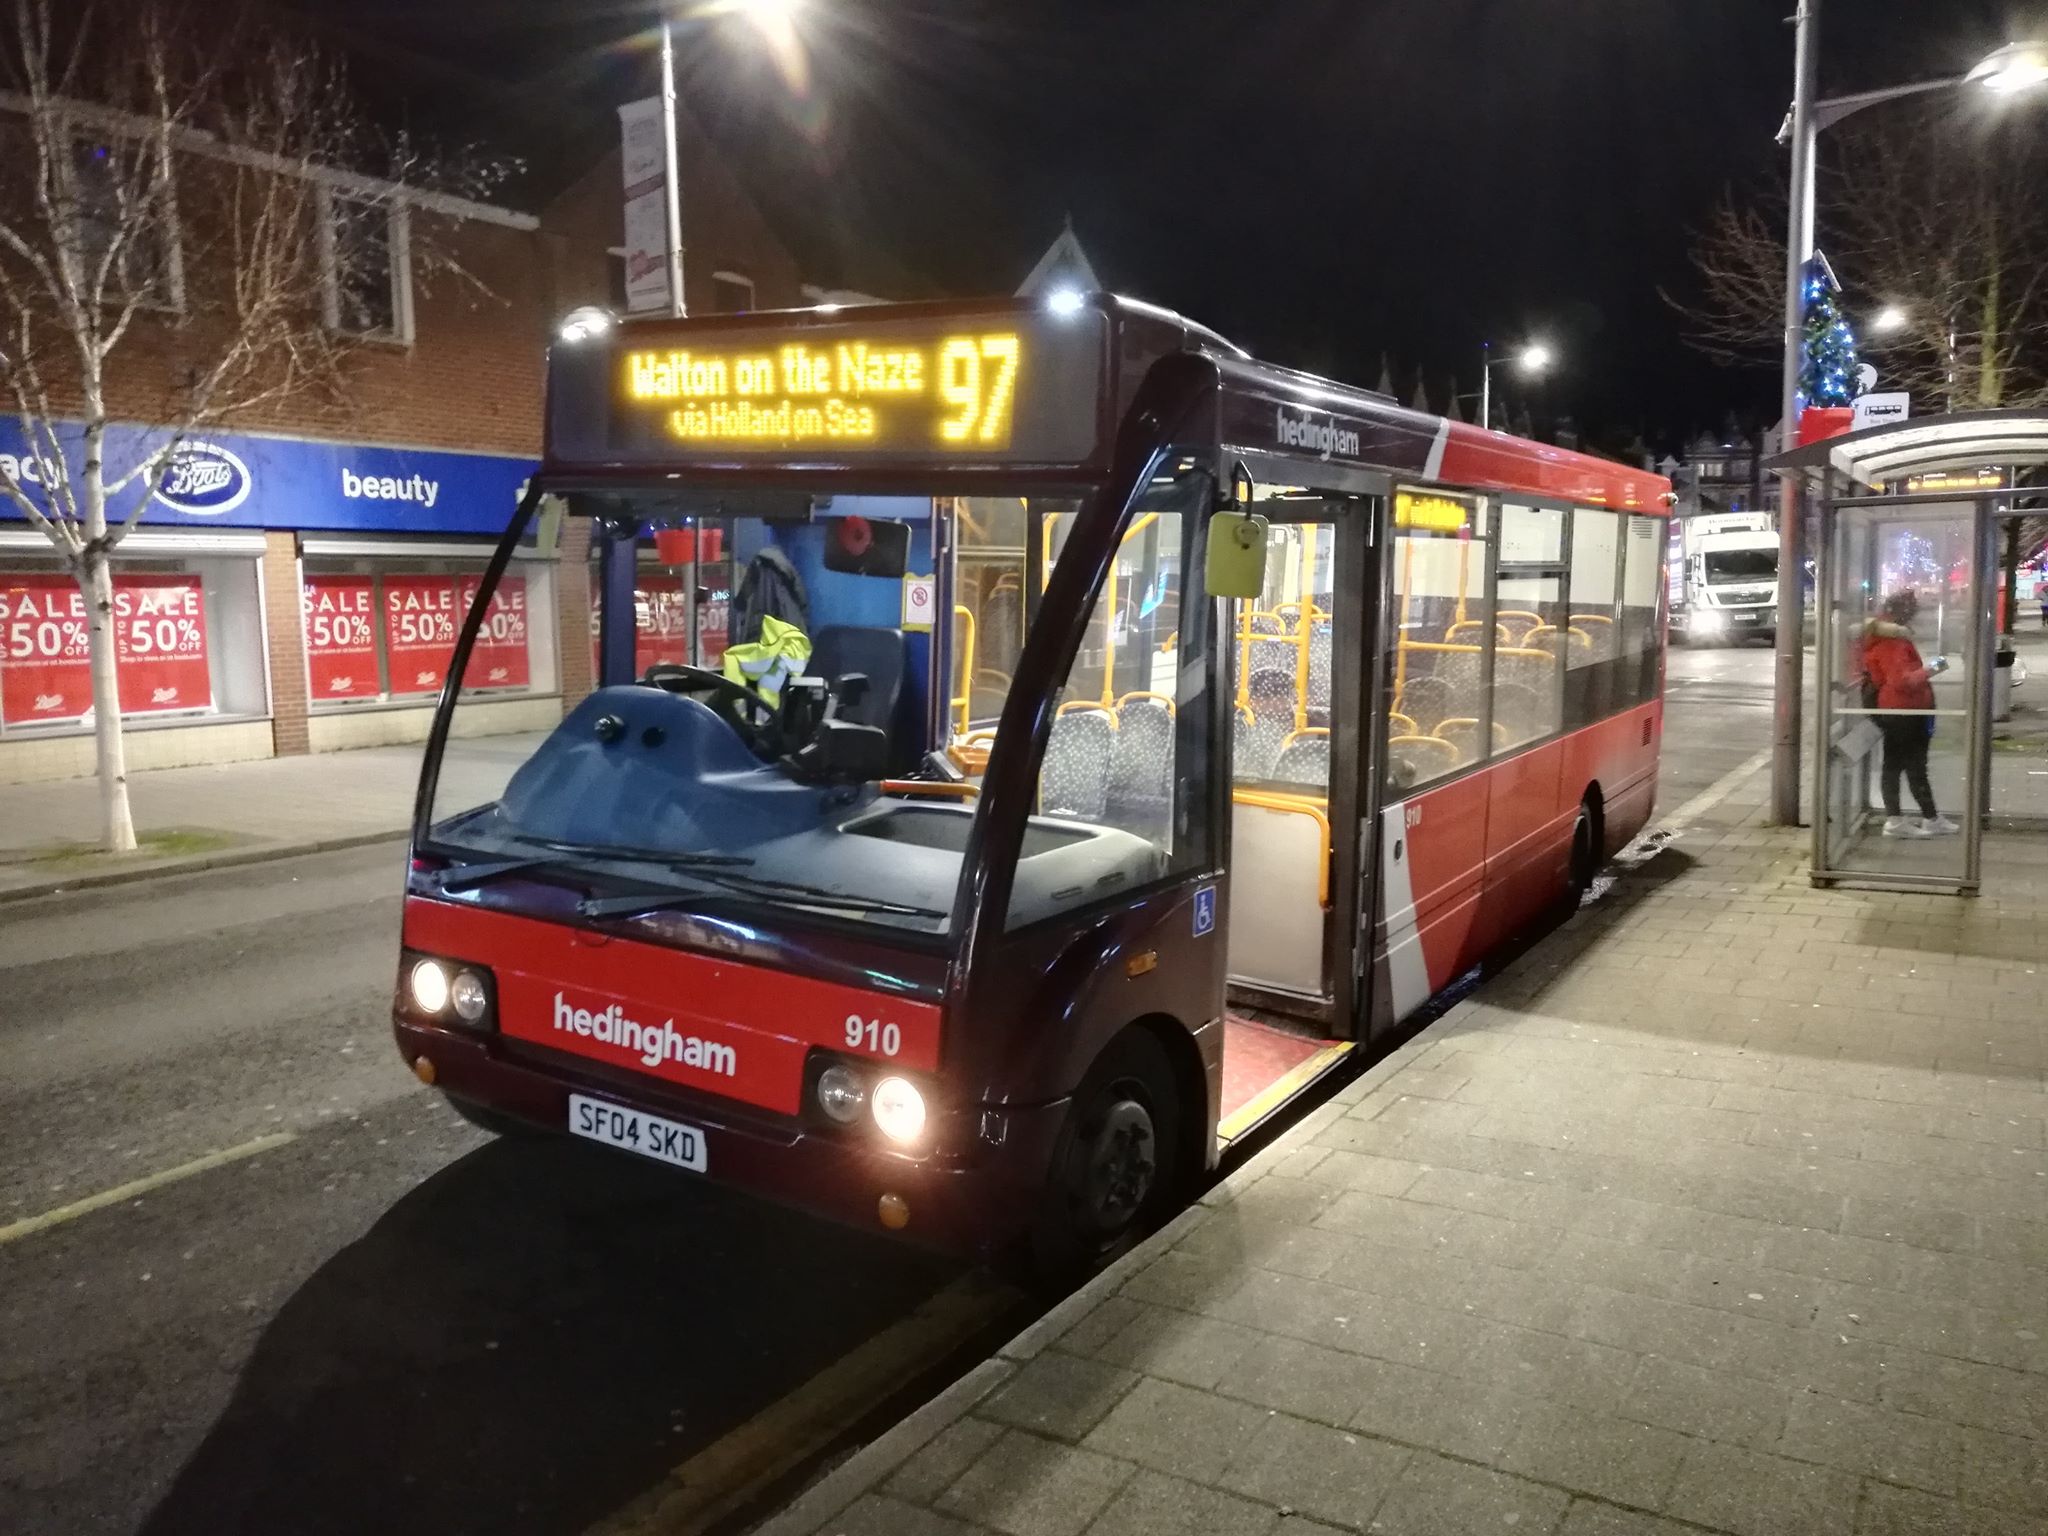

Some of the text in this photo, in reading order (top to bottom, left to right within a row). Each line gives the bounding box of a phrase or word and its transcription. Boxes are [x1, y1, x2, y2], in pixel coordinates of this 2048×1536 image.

[630, 343, 924, 397] Walton on the Naze
[940, 333, 1019, 441] 97
[673, 399, 875, 436] via Holland on Sea
[1276, 406, 1360, 462] hedingham
[165, 454, 233, 495] Boots
[342, 467, 439, 507] beauty
[115, 592, 199, 616] SALE
[304, 591, 370, 613] SALE
[389, 590, 452, 612] SALE
[463, 590, 524, 610] SLE
[11, 621, 89, 658] 50%
[131, 619, 201, 653] 50% OFF
[314, 615, 371, 646] 50% OFF
[401, 613, 454, 643] 50% OFF
[1406, 804, 1422, 829] 910
[554, 991, 737, 1077] hedingham
[845, 1014, 901, 1056] 910
[579, 1102, 696, 1163] SF04 SKD
